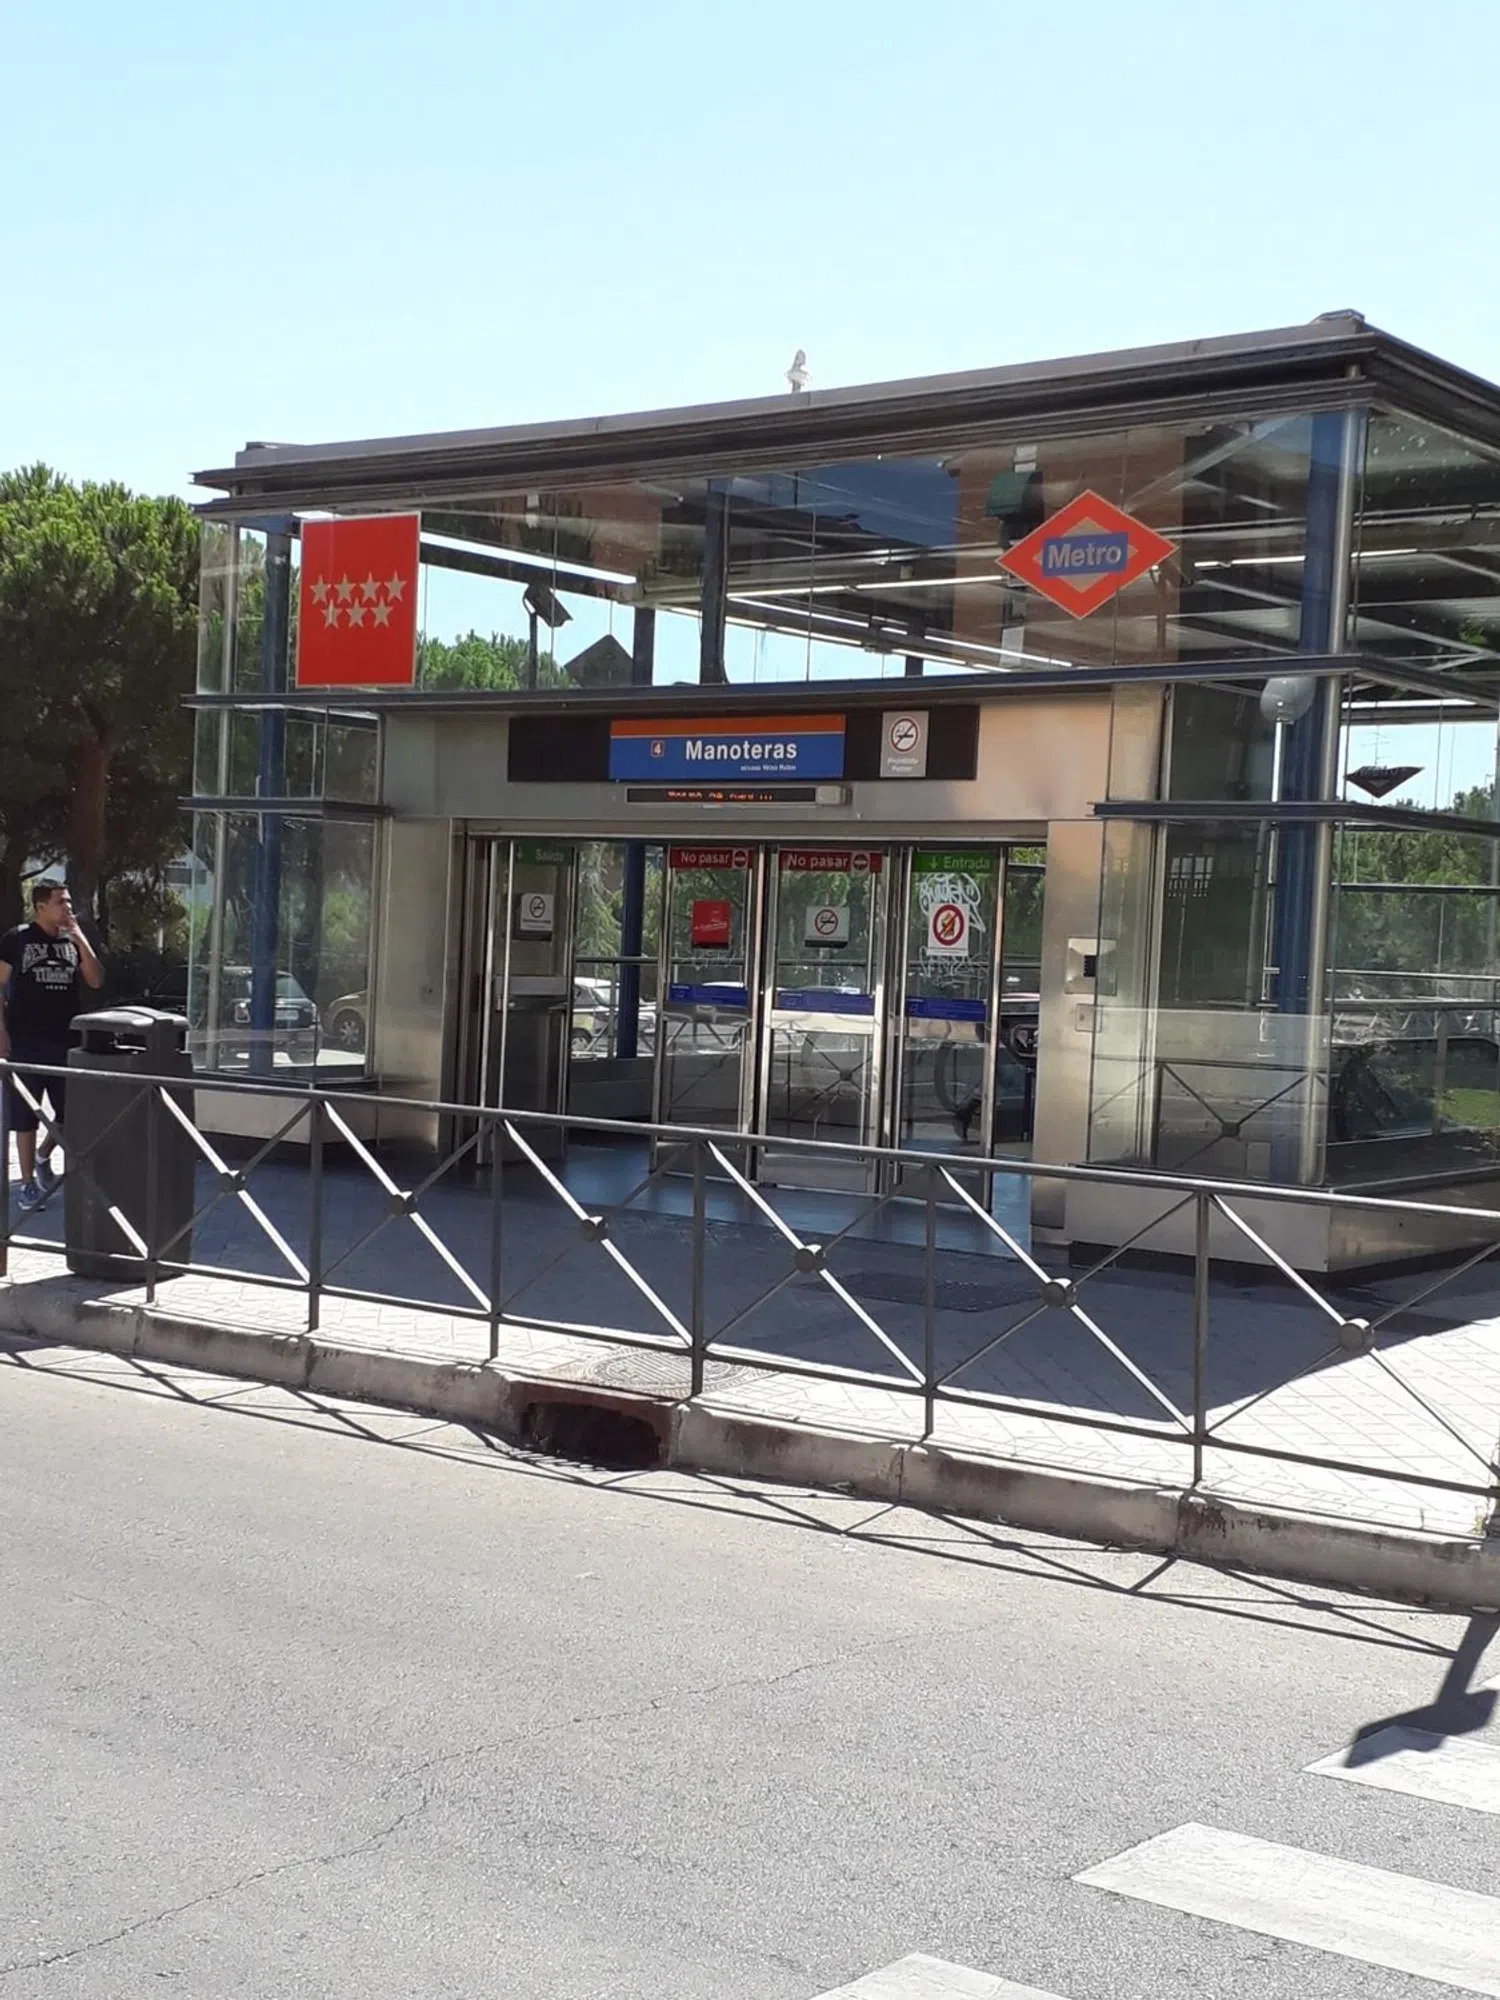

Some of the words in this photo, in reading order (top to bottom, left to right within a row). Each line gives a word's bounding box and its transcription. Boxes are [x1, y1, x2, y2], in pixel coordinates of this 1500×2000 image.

[1048, 544, 1121, 569] Metro
[685, 739, 797, 760] Manoteras
[681, 852, 697, 864] No
[699, 853, 730, 867] pasar
[788, 854, 808, 867] No
[811, 856, 848, 870] pasar
[943, 856, 991, 870] Entrada
